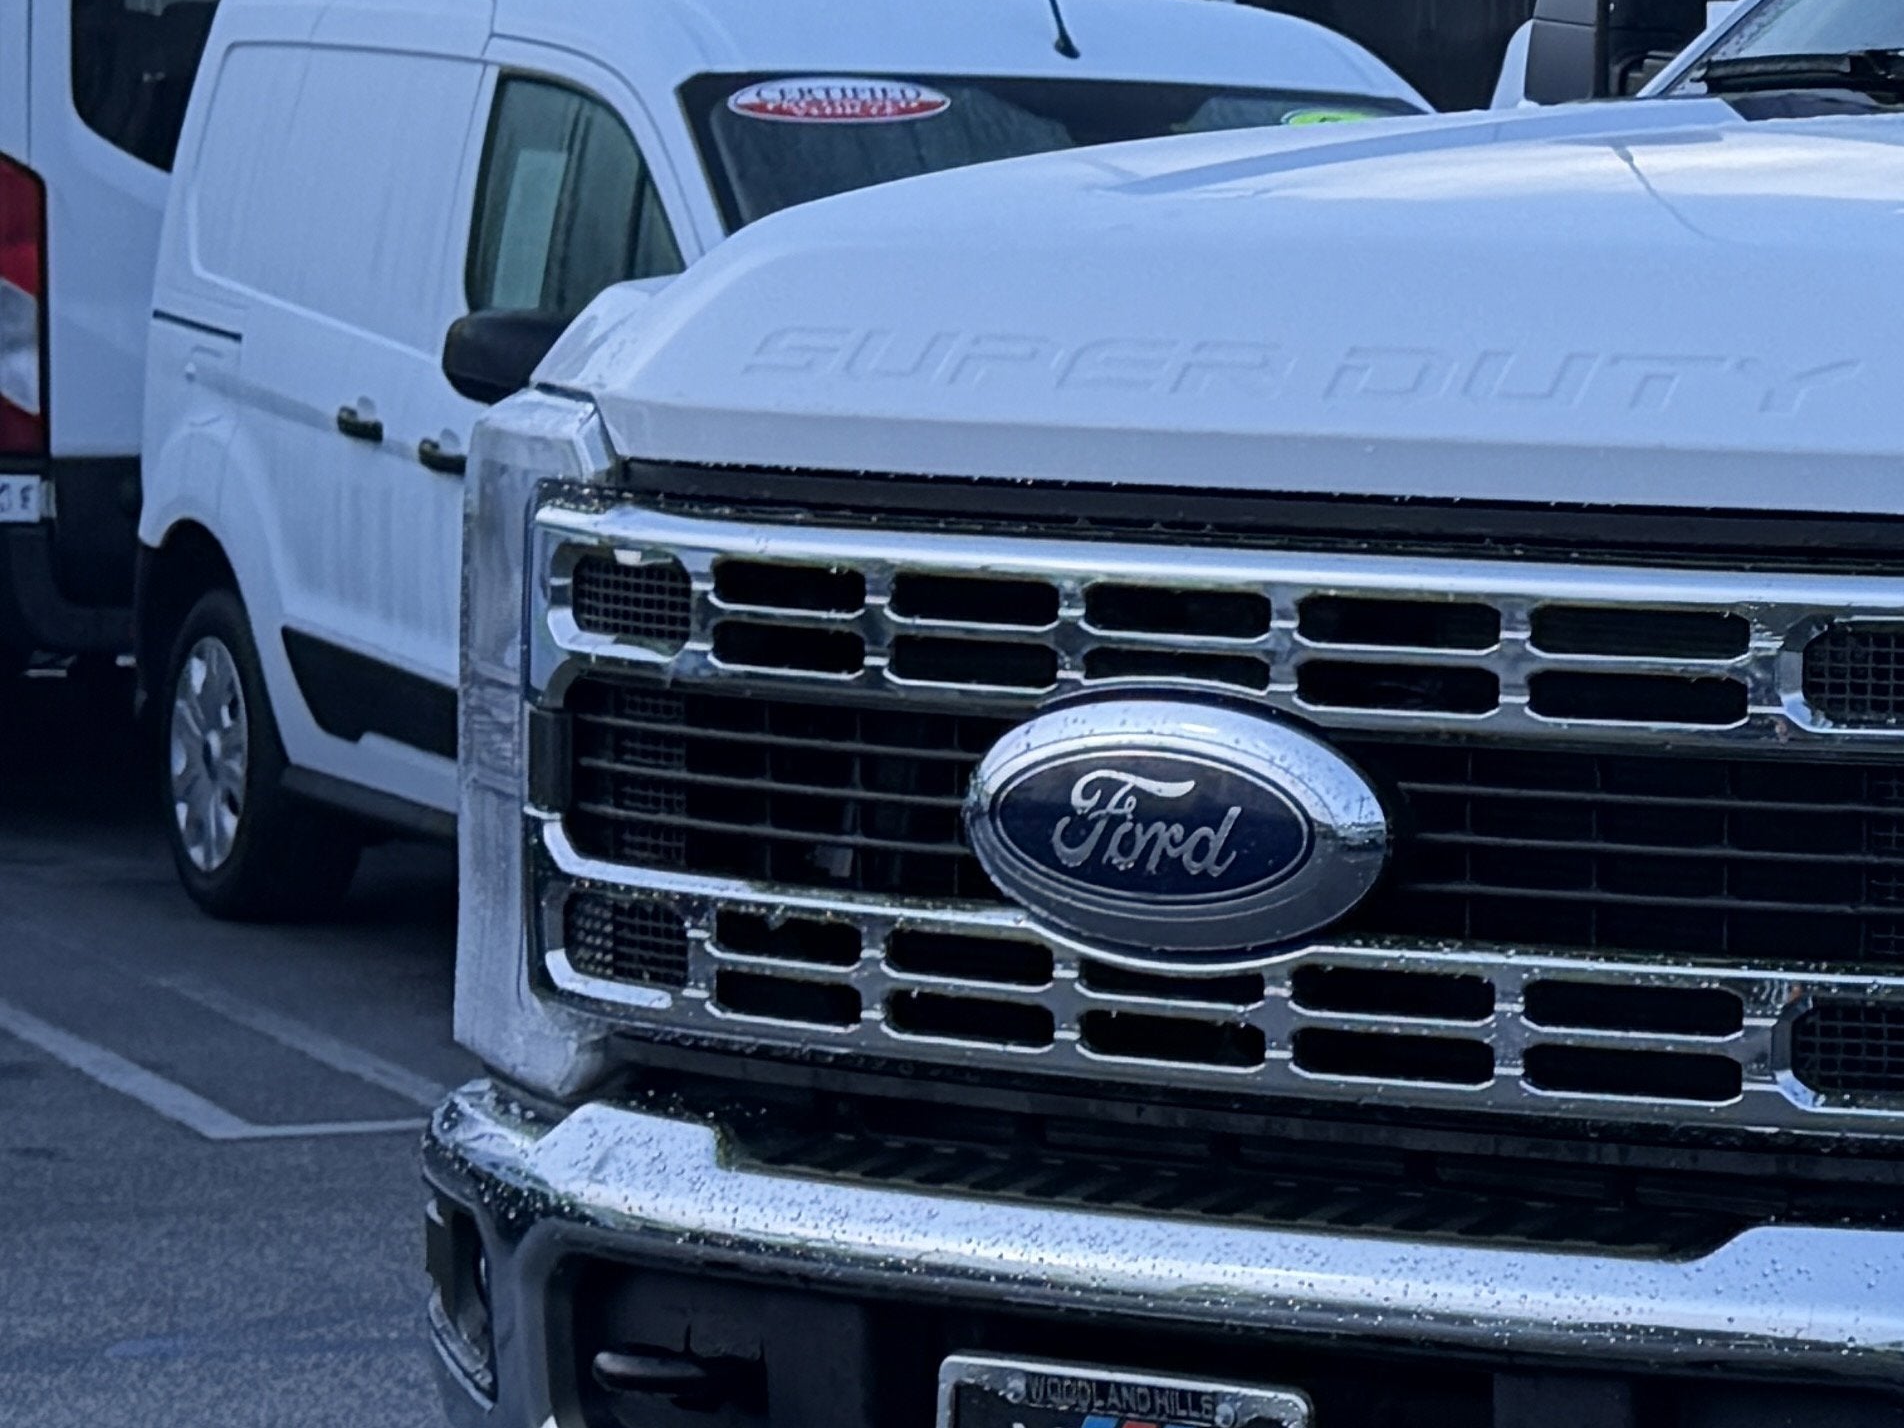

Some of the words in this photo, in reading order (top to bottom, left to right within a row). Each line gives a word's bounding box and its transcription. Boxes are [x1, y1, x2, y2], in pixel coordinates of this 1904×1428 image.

[756, 85, 922, 106] CERTIFIED
[738, 324, 1284, 398] SUPER
[1319, 344, 1866, 416] DUTY
[1051, 768, 1243, 879] Ford
[1027, 1373, 1151, 1414] WOODLAND
[1153, 1388, 1216, 1420] HILLS
